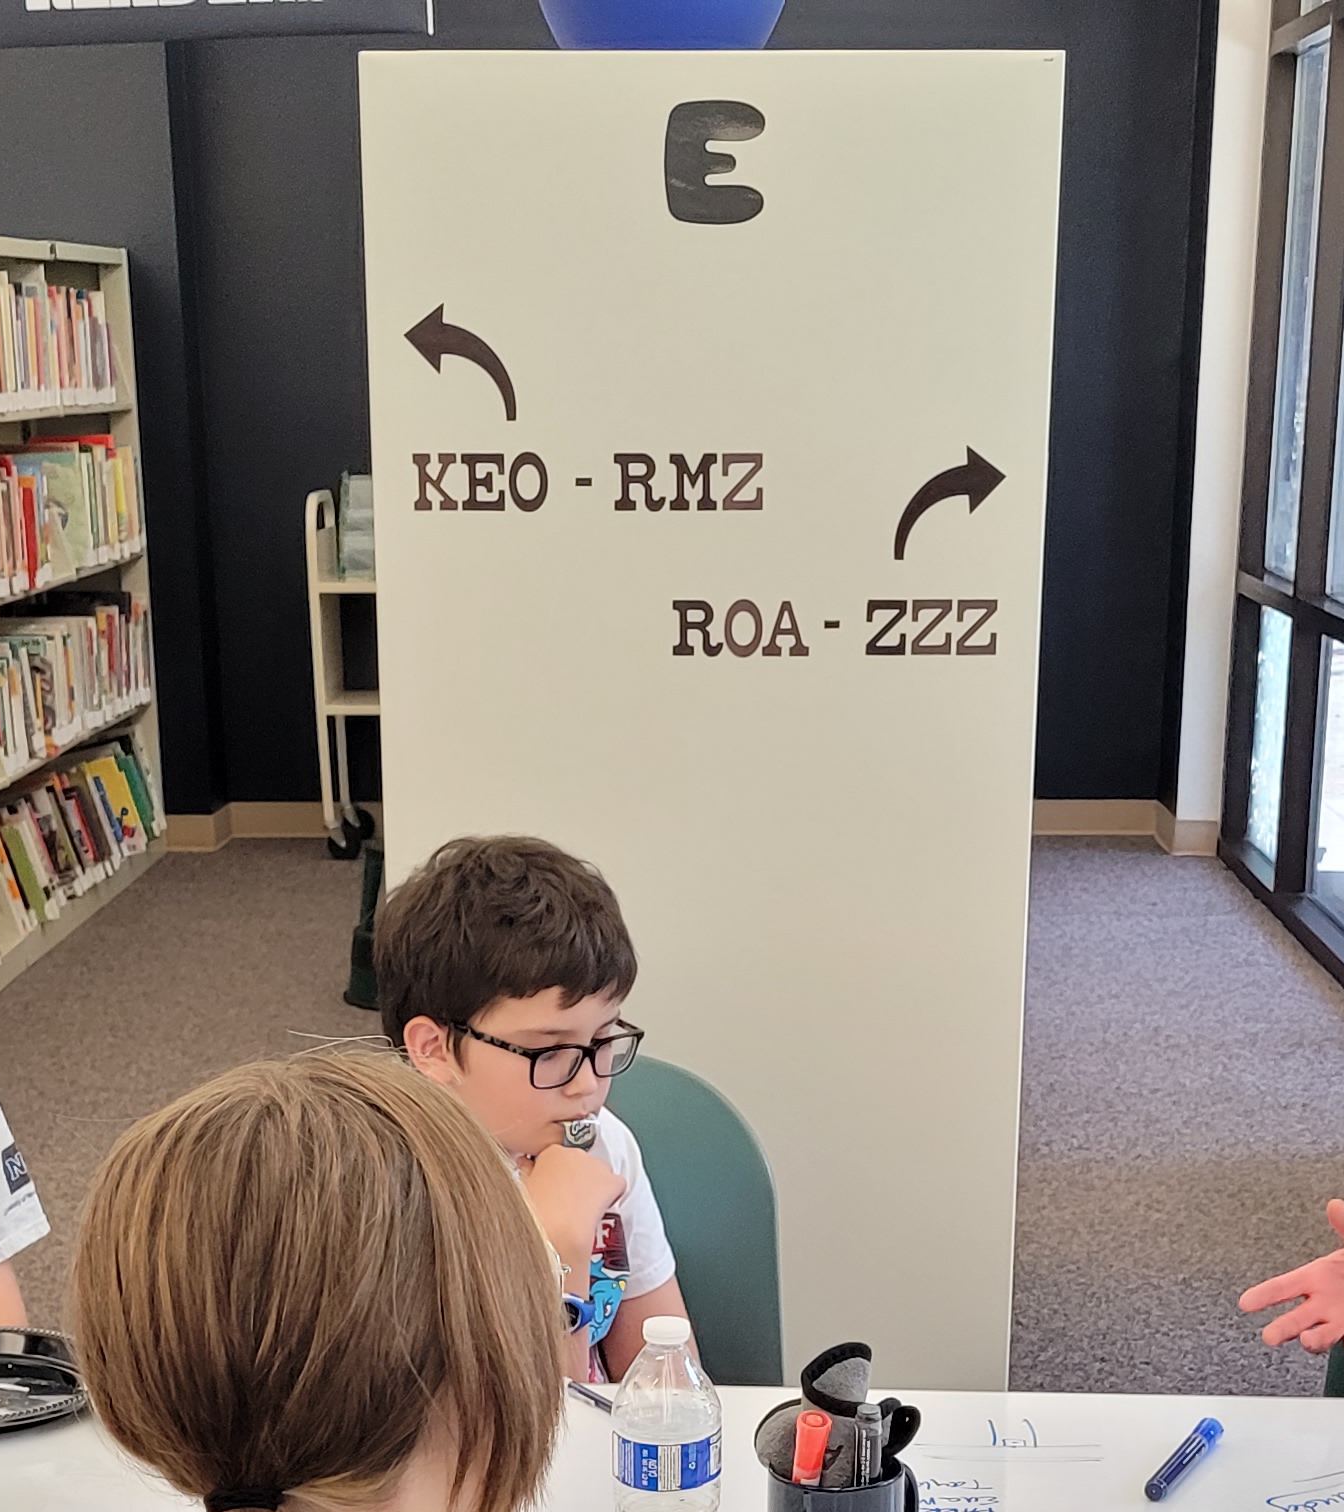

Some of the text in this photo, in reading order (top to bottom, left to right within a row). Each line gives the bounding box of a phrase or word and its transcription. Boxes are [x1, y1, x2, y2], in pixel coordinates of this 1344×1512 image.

[664, 99, 766, 225] E
[411, 452, 548, 512] KEO
[613, 452, 764, 512] RMZ
[672, 599, 810, 658] ROA
[865, 599, 999, 656] ZZZ
[5, 1151, 28, 1181] N
